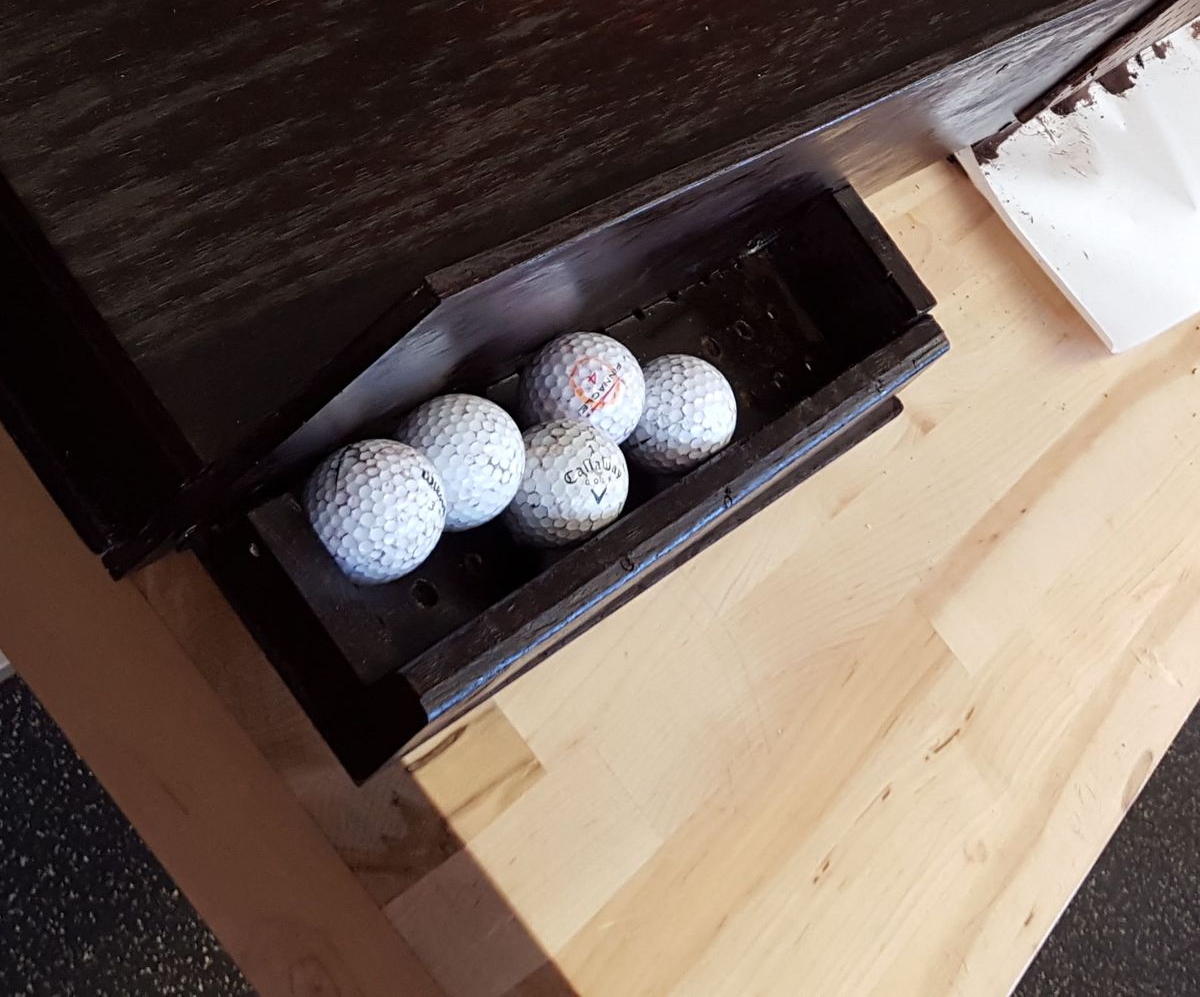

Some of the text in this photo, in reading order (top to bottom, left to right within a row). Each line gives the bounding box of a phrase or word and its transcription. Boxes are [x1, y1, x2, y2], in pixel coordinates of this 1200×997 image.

[577, 362, 622, 417] PINNACLE
[588, 371, 597, 385] 4
[564, 456, 622, 484] Callaway
